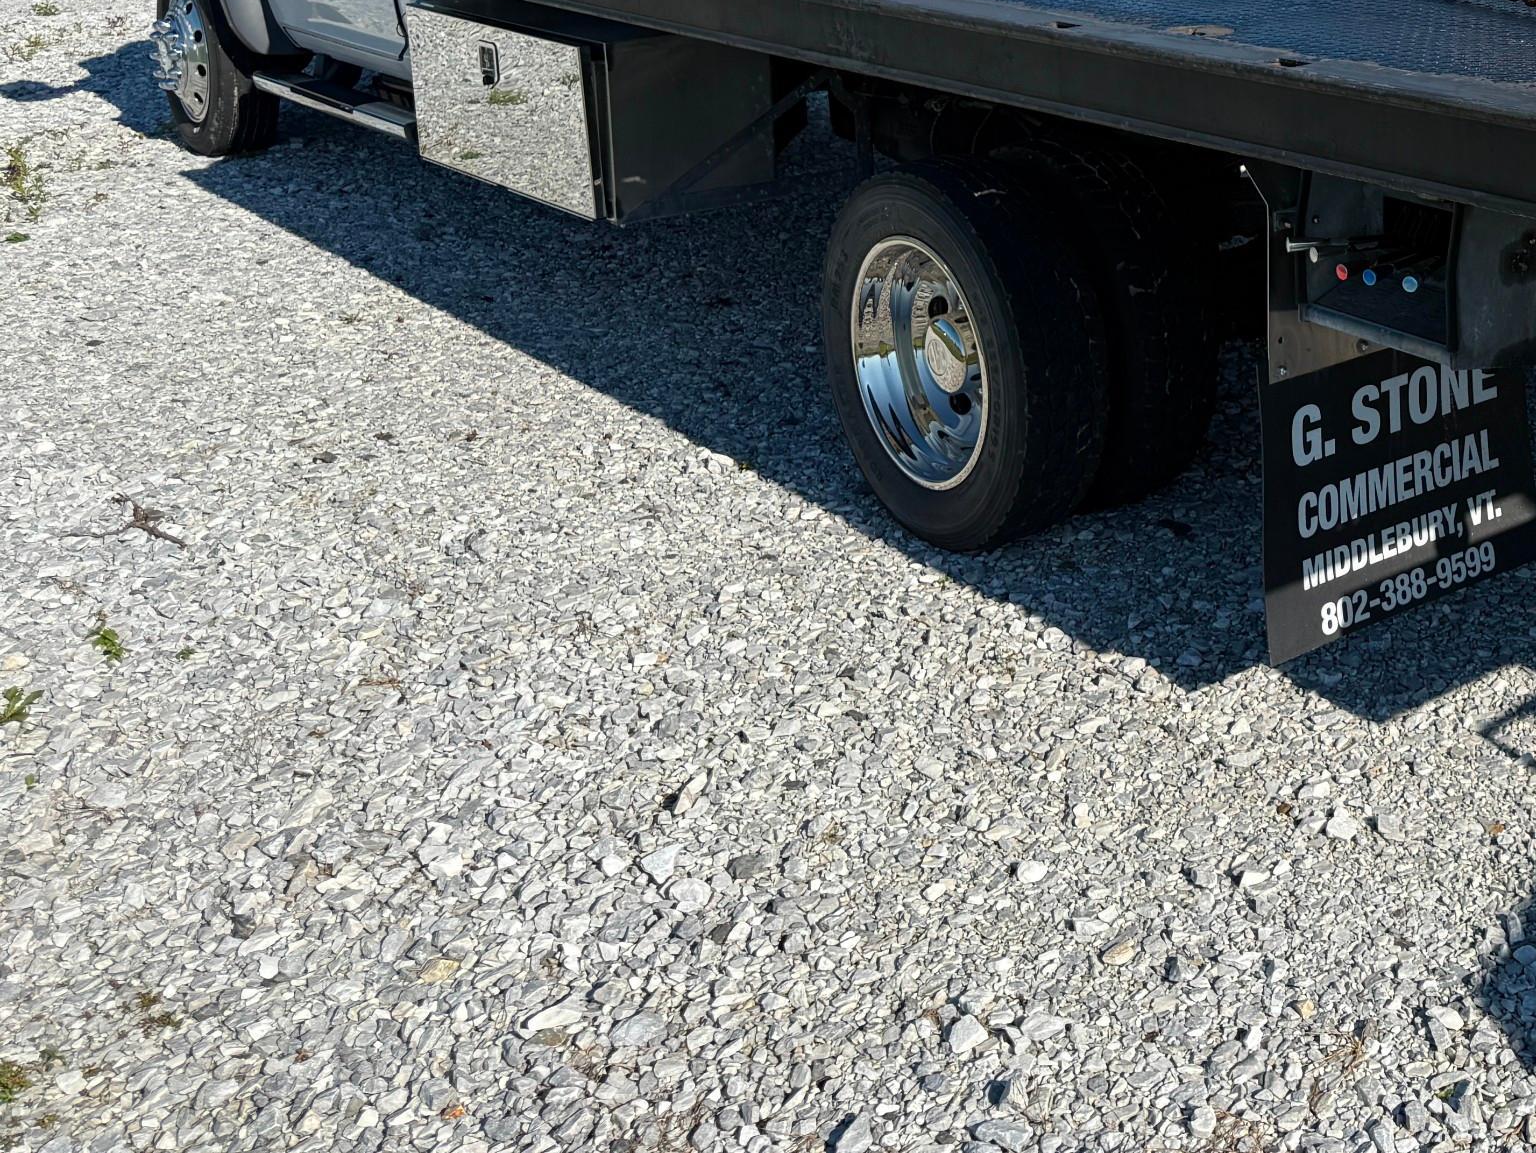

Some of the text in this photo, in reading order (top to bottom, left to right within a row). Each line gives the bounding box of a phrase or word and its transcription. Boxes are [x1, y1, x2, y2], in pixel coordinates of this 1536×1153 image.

[1291, 365, 1498, 467] G. STONE
[1297, 428, 1500, 539] COMMERCIAL
[1302, 488, 1502, 591] MIDDLEBURY, VT.
[1320, 540, 1496, 636] 802-388-9599
